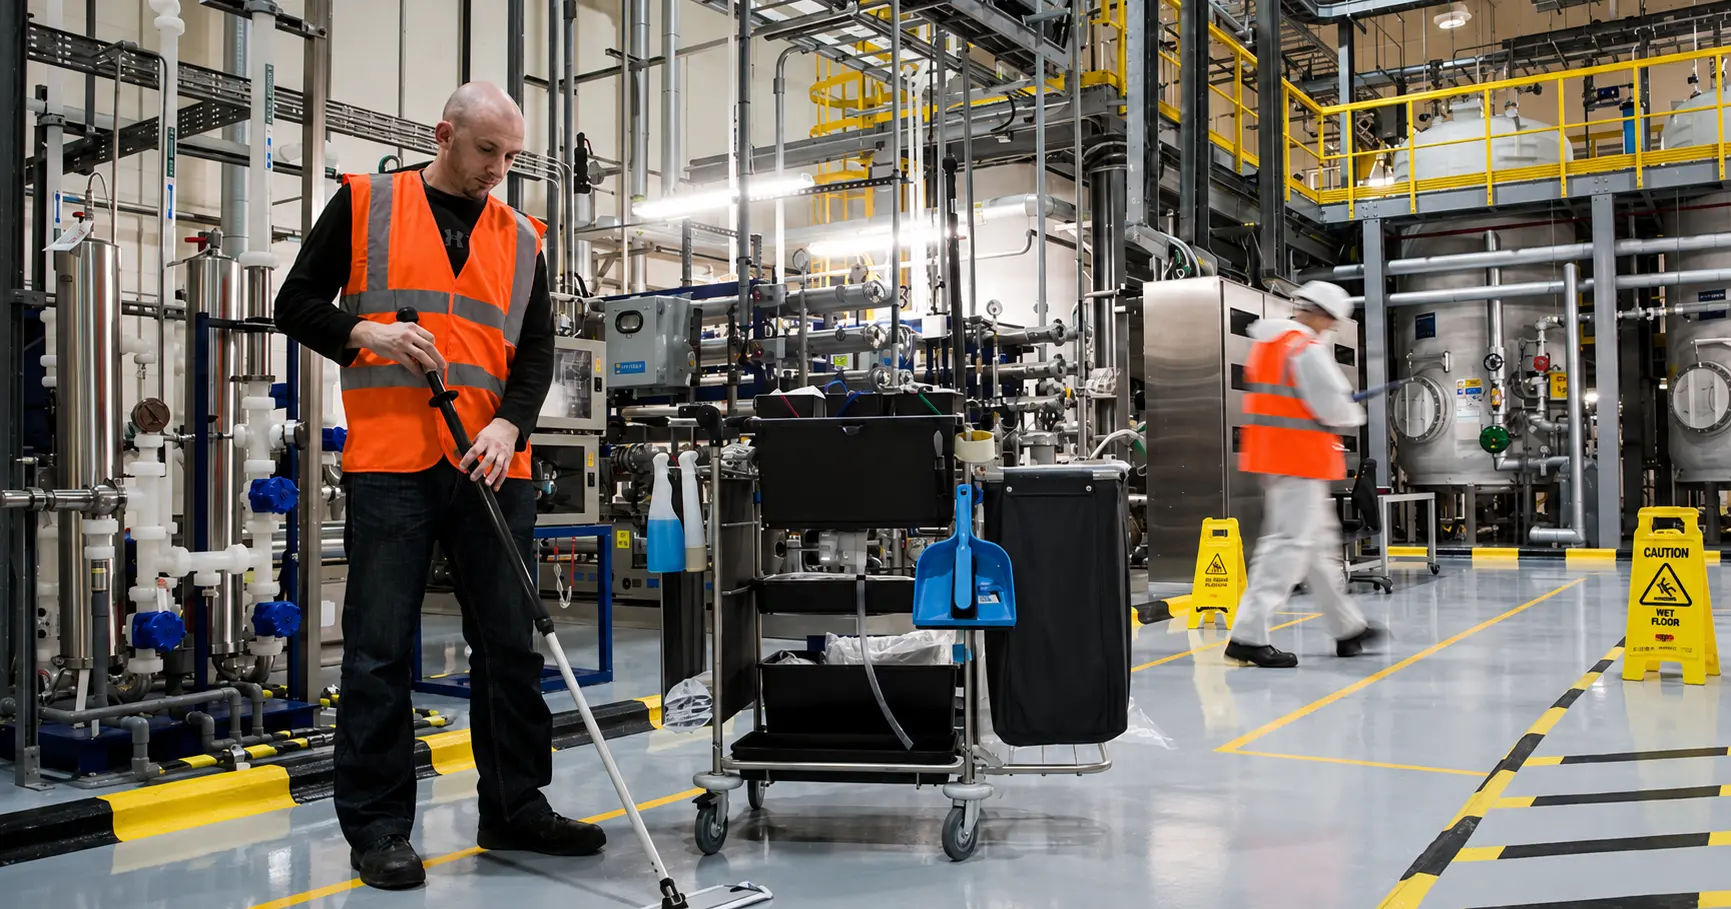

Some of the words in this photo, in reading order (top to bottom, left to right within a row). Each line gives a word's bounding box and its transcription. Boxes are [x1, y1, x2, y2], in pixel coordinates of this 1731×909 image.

[1643, 547, 1689, 558] CAUTION
[1656, 608, 1675, 617] WET
[1651, 617, 1680, 627] FLOOR
